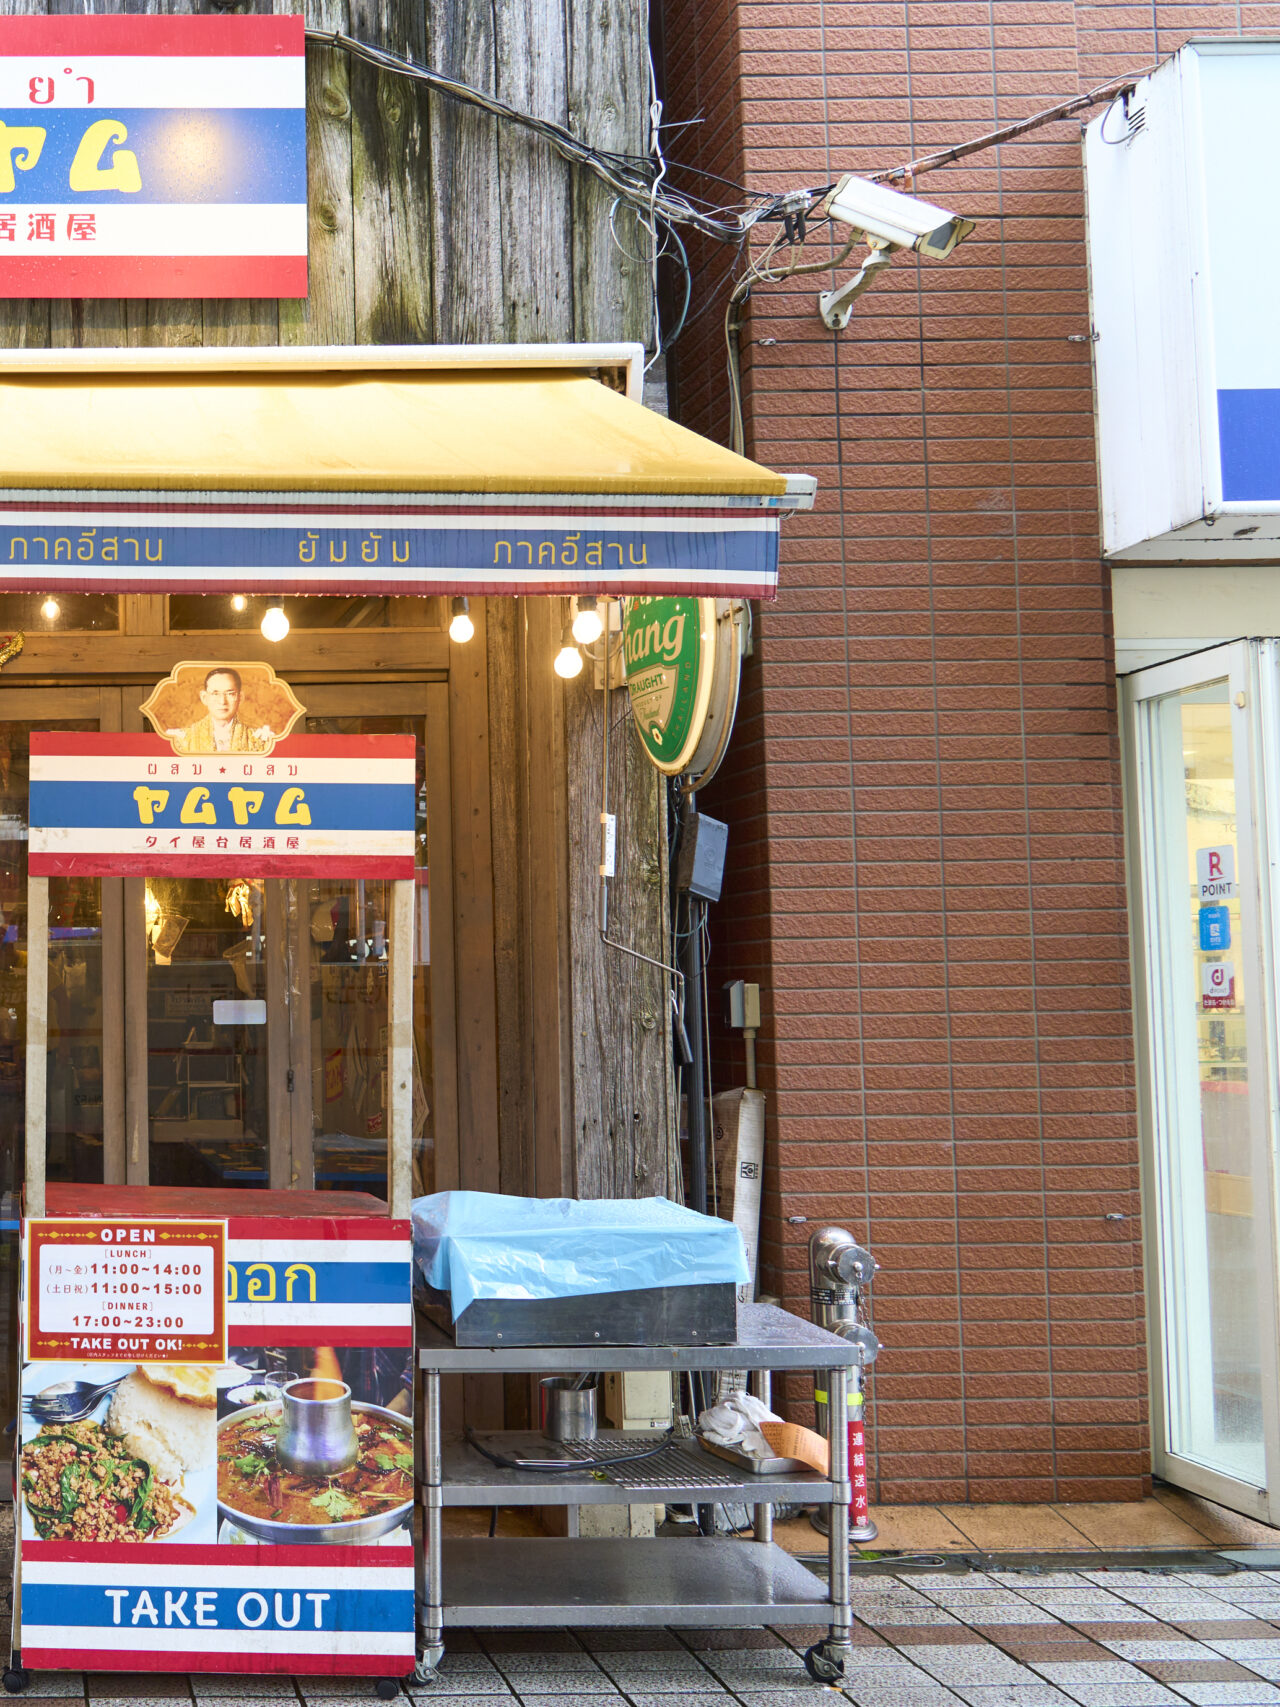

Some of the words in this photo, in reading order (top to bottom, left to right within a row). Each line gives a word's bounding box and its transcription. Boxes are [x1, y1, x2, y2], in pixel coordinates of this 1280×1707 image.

[28, 67, 95, 105] ยำ
[9, 528, 164, 562] ภาคอีสาน
[493, 531, 649, 566] ภาคอีสาน
[623, 615, 686, 665] hang
[133, 786, 312, 826] ヤムヤム
[145, 835, 300, 851] タイ屋台居酒屋
[1202, 882, 1233, 897] POINT
[100, 1228, 156, 1243] OPEN
[70, 1337, 112, 1351] TAKE
[117, 1338, 150, 1351] OUT
[155, 1338, 183, 1352] OK!
[105, 1589, 218, 1627] TAKE
[236, 1592, 331, 1628] OUT
